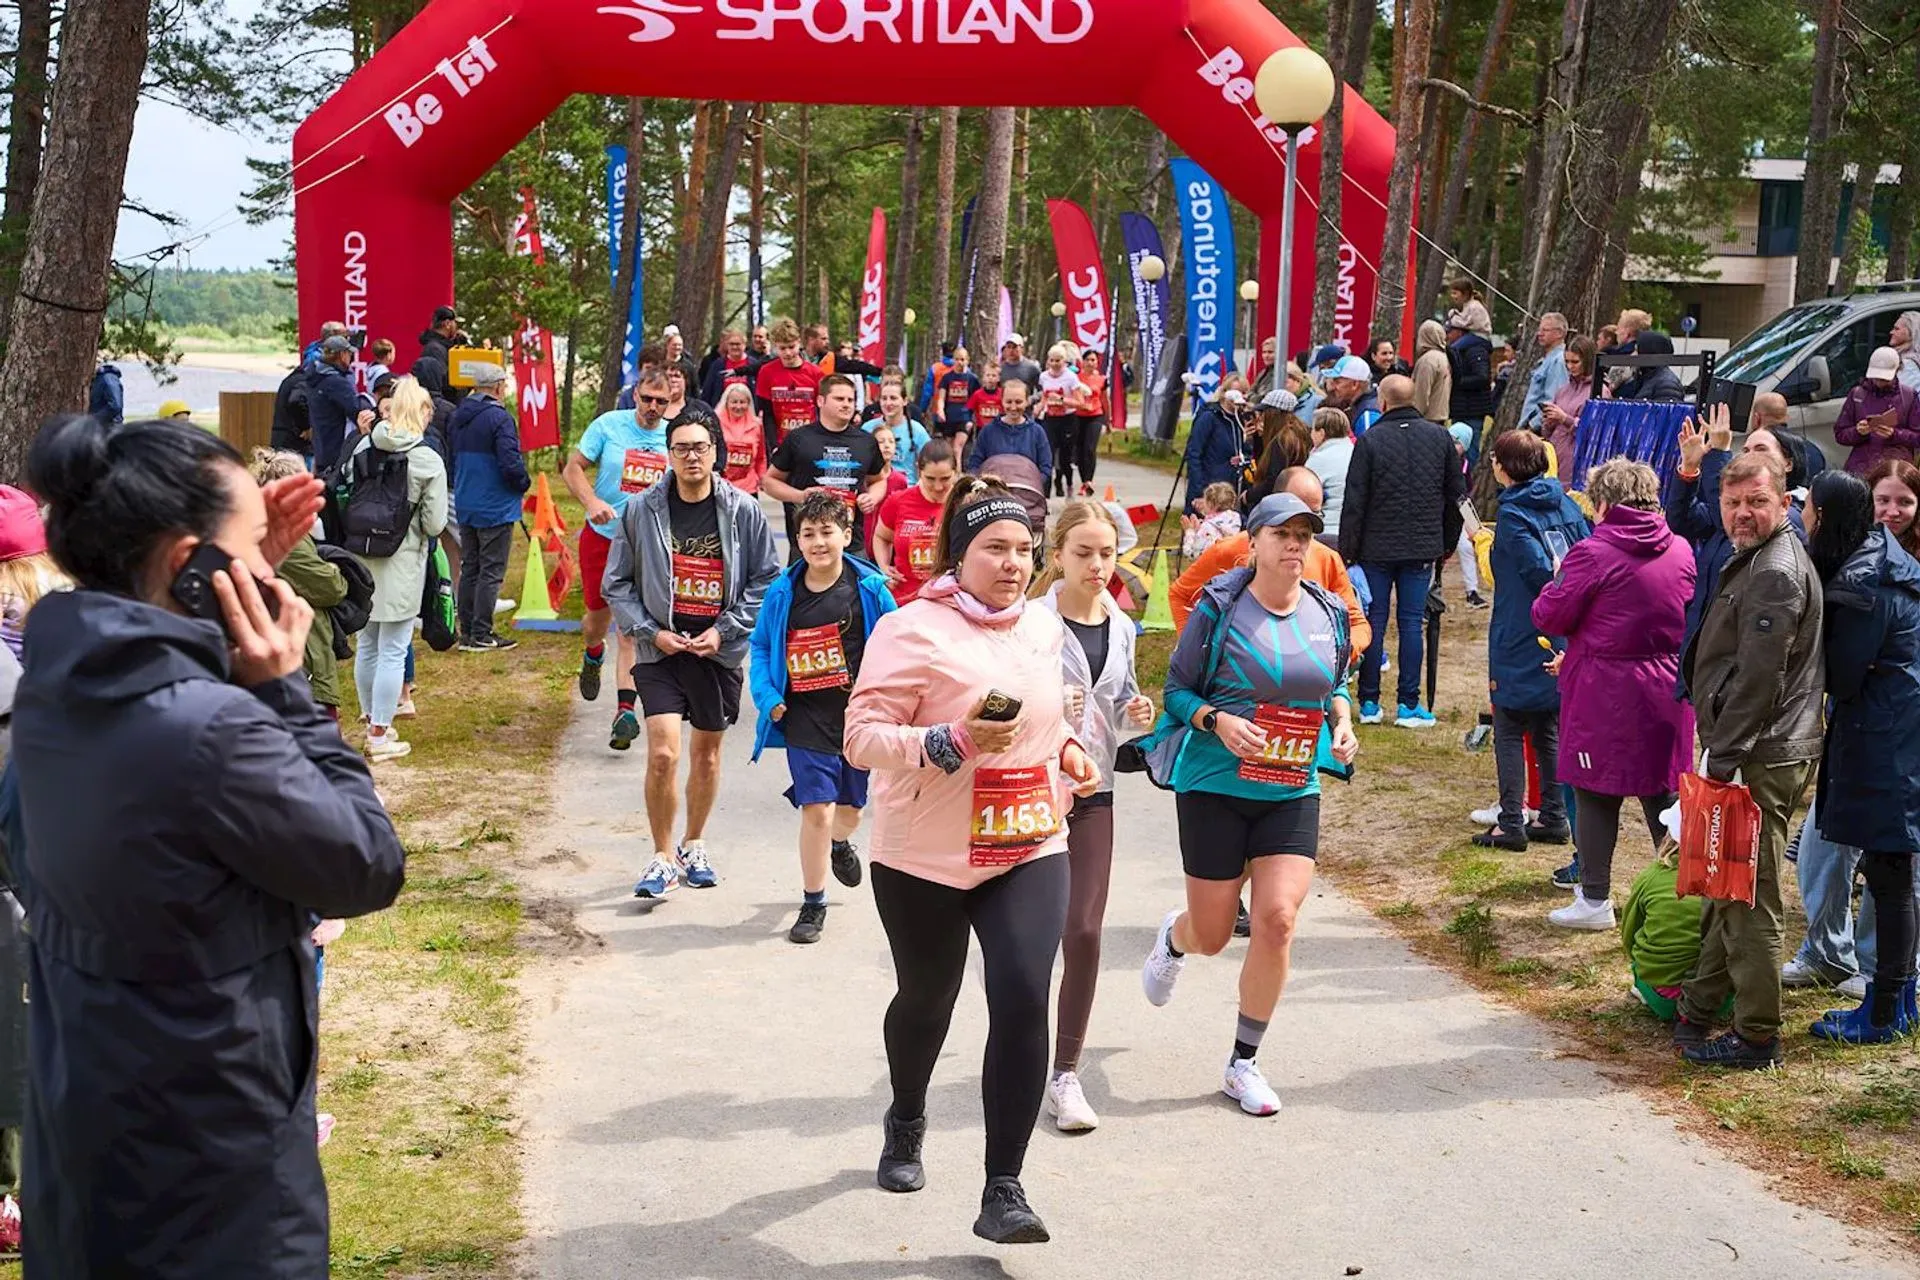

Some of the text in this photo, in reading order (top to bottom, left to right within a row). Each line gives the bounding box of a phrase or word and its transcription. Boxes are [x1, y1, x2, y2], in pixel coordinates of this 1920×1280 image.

[716, 0, 1095, 44] SPORTLAND
[383, 35, 498, 148] Be 1st
[1196, 45, 1255, 105] Be
[859, 261, 882, 348] KFC
[1068, 265, 1108, 354] KFC
[913, 547, 934, 565] 11
[672, 576, 720, 599] 1138
[790, 647, 841, 673] 1135
[1267, 735, 1313, 762] 115
[980, 801, 1054, 836] 1153
[1709, 804, 1721, 860] SPORTLAND
